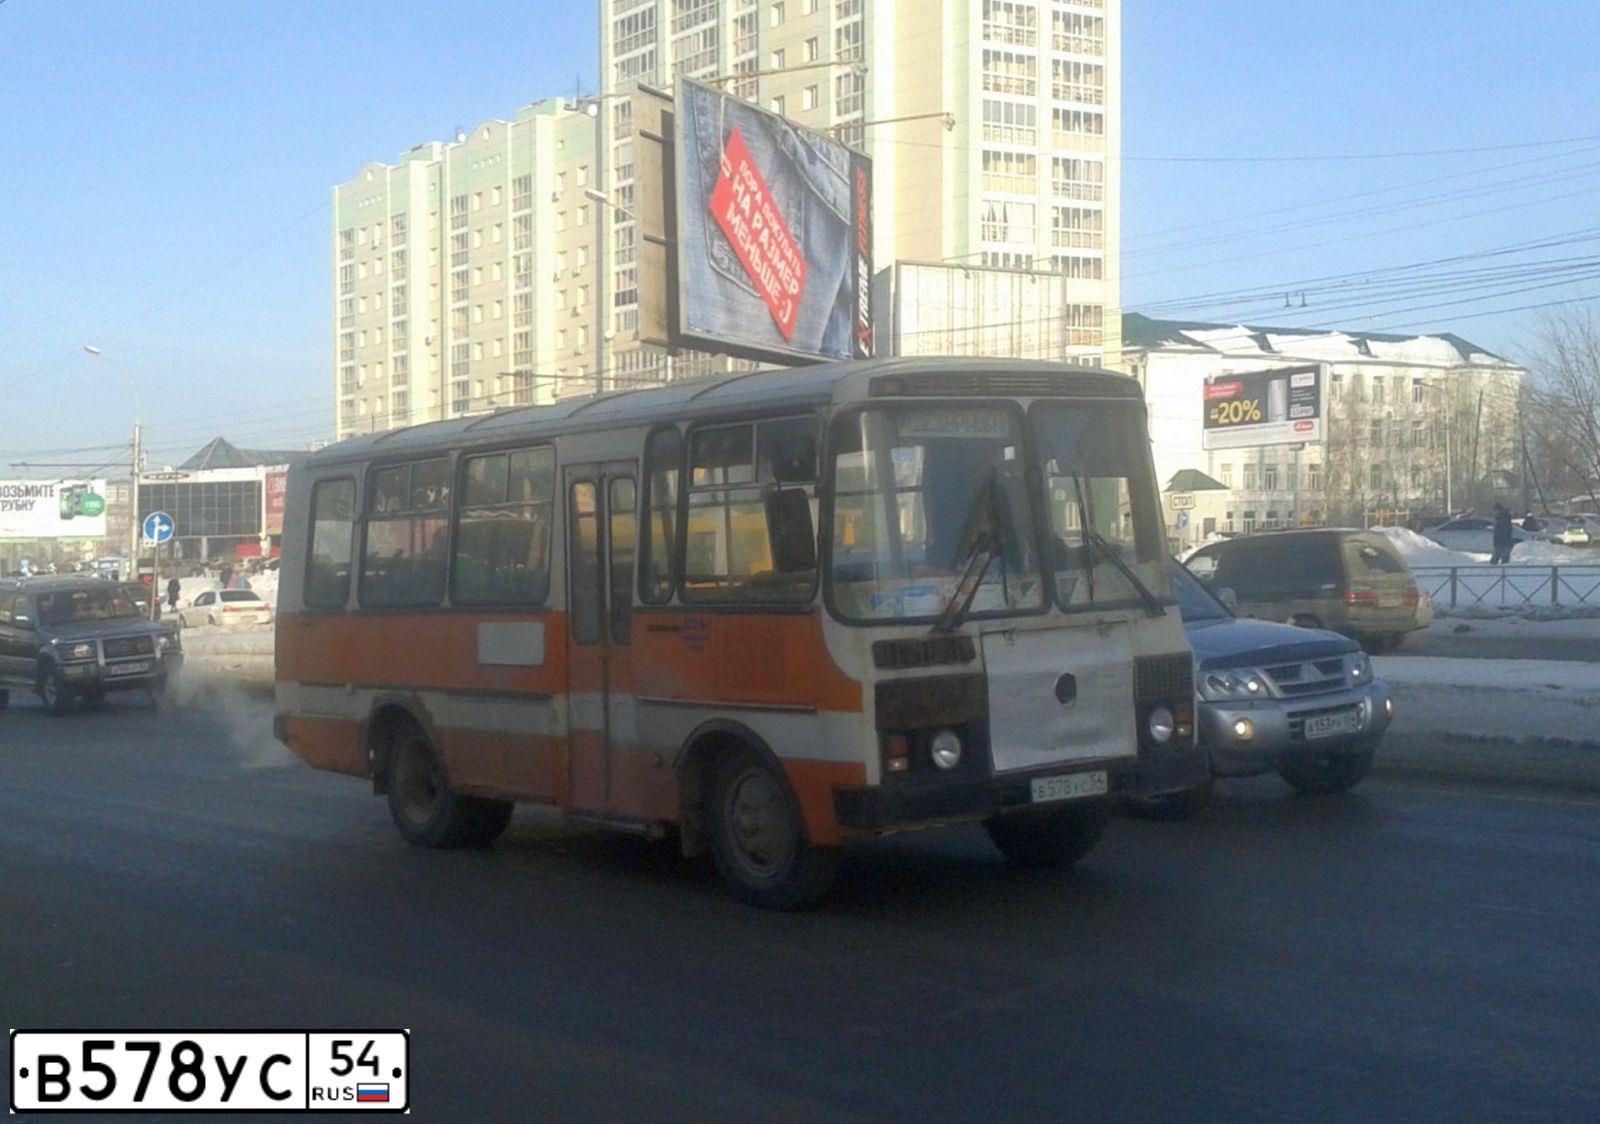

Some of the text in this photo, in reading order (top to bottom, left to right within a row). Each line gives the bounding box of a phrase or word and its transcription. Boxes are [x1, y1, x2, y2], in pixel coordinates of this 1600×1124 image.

[726, 201, 781, 304] МЕНЬШЕ
[732, 174, 799, 295] НА РАЗМЕР
[739, 159, 802, 277] ПОРА ПОКУПАТЬ
[856, 255, 873, 357] EXTREME
